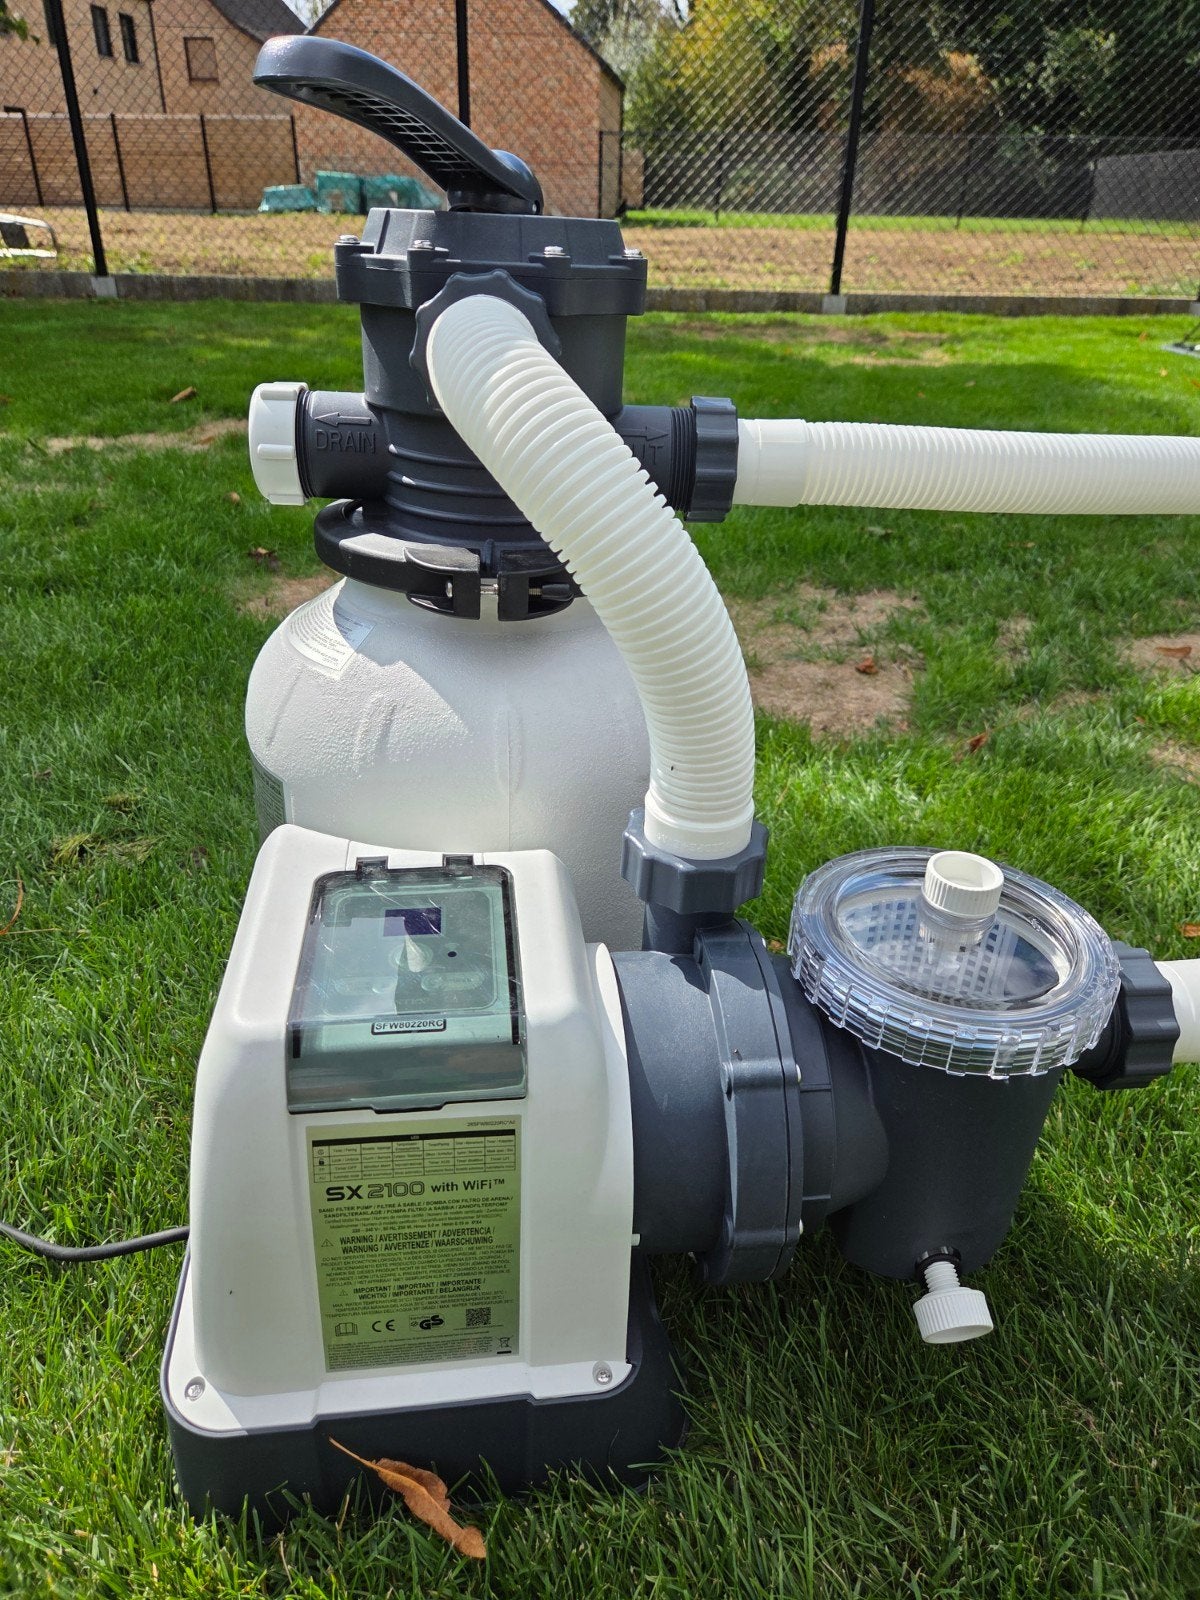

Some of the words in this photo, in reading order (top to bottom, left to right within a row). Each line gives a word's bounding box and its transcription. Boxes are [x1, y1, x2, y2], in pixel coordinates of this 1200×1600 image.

[315, 429, 376, 454] DRAIN
[628, 441, 664, 466] UT
[375, 1019, 443, 1030] SFW80220RC
[326, 1185, 364, 1201] SX
[368, 1181, 424, 1198] 2100
[431, 1181, 458, 1193] with
[340, 1235, 373, 1245] WARNING
[379, 1230, 436, 1242] AVERTISSEMENT
[442, 1227, 491, 1238] ADVERTENCIA
[342, 1244, 378, 1254] WARNUNG
[385, 1241, 430, 1251] AVVERTENZE
[435, 1236, 493, 1247] WAARSCHUWING
[392, 1289, 434, 1297] IMPORTANTE
[440, 1285, 480, 1293] BELANGRIJK
[419, 1314, 444, 1330] GS
